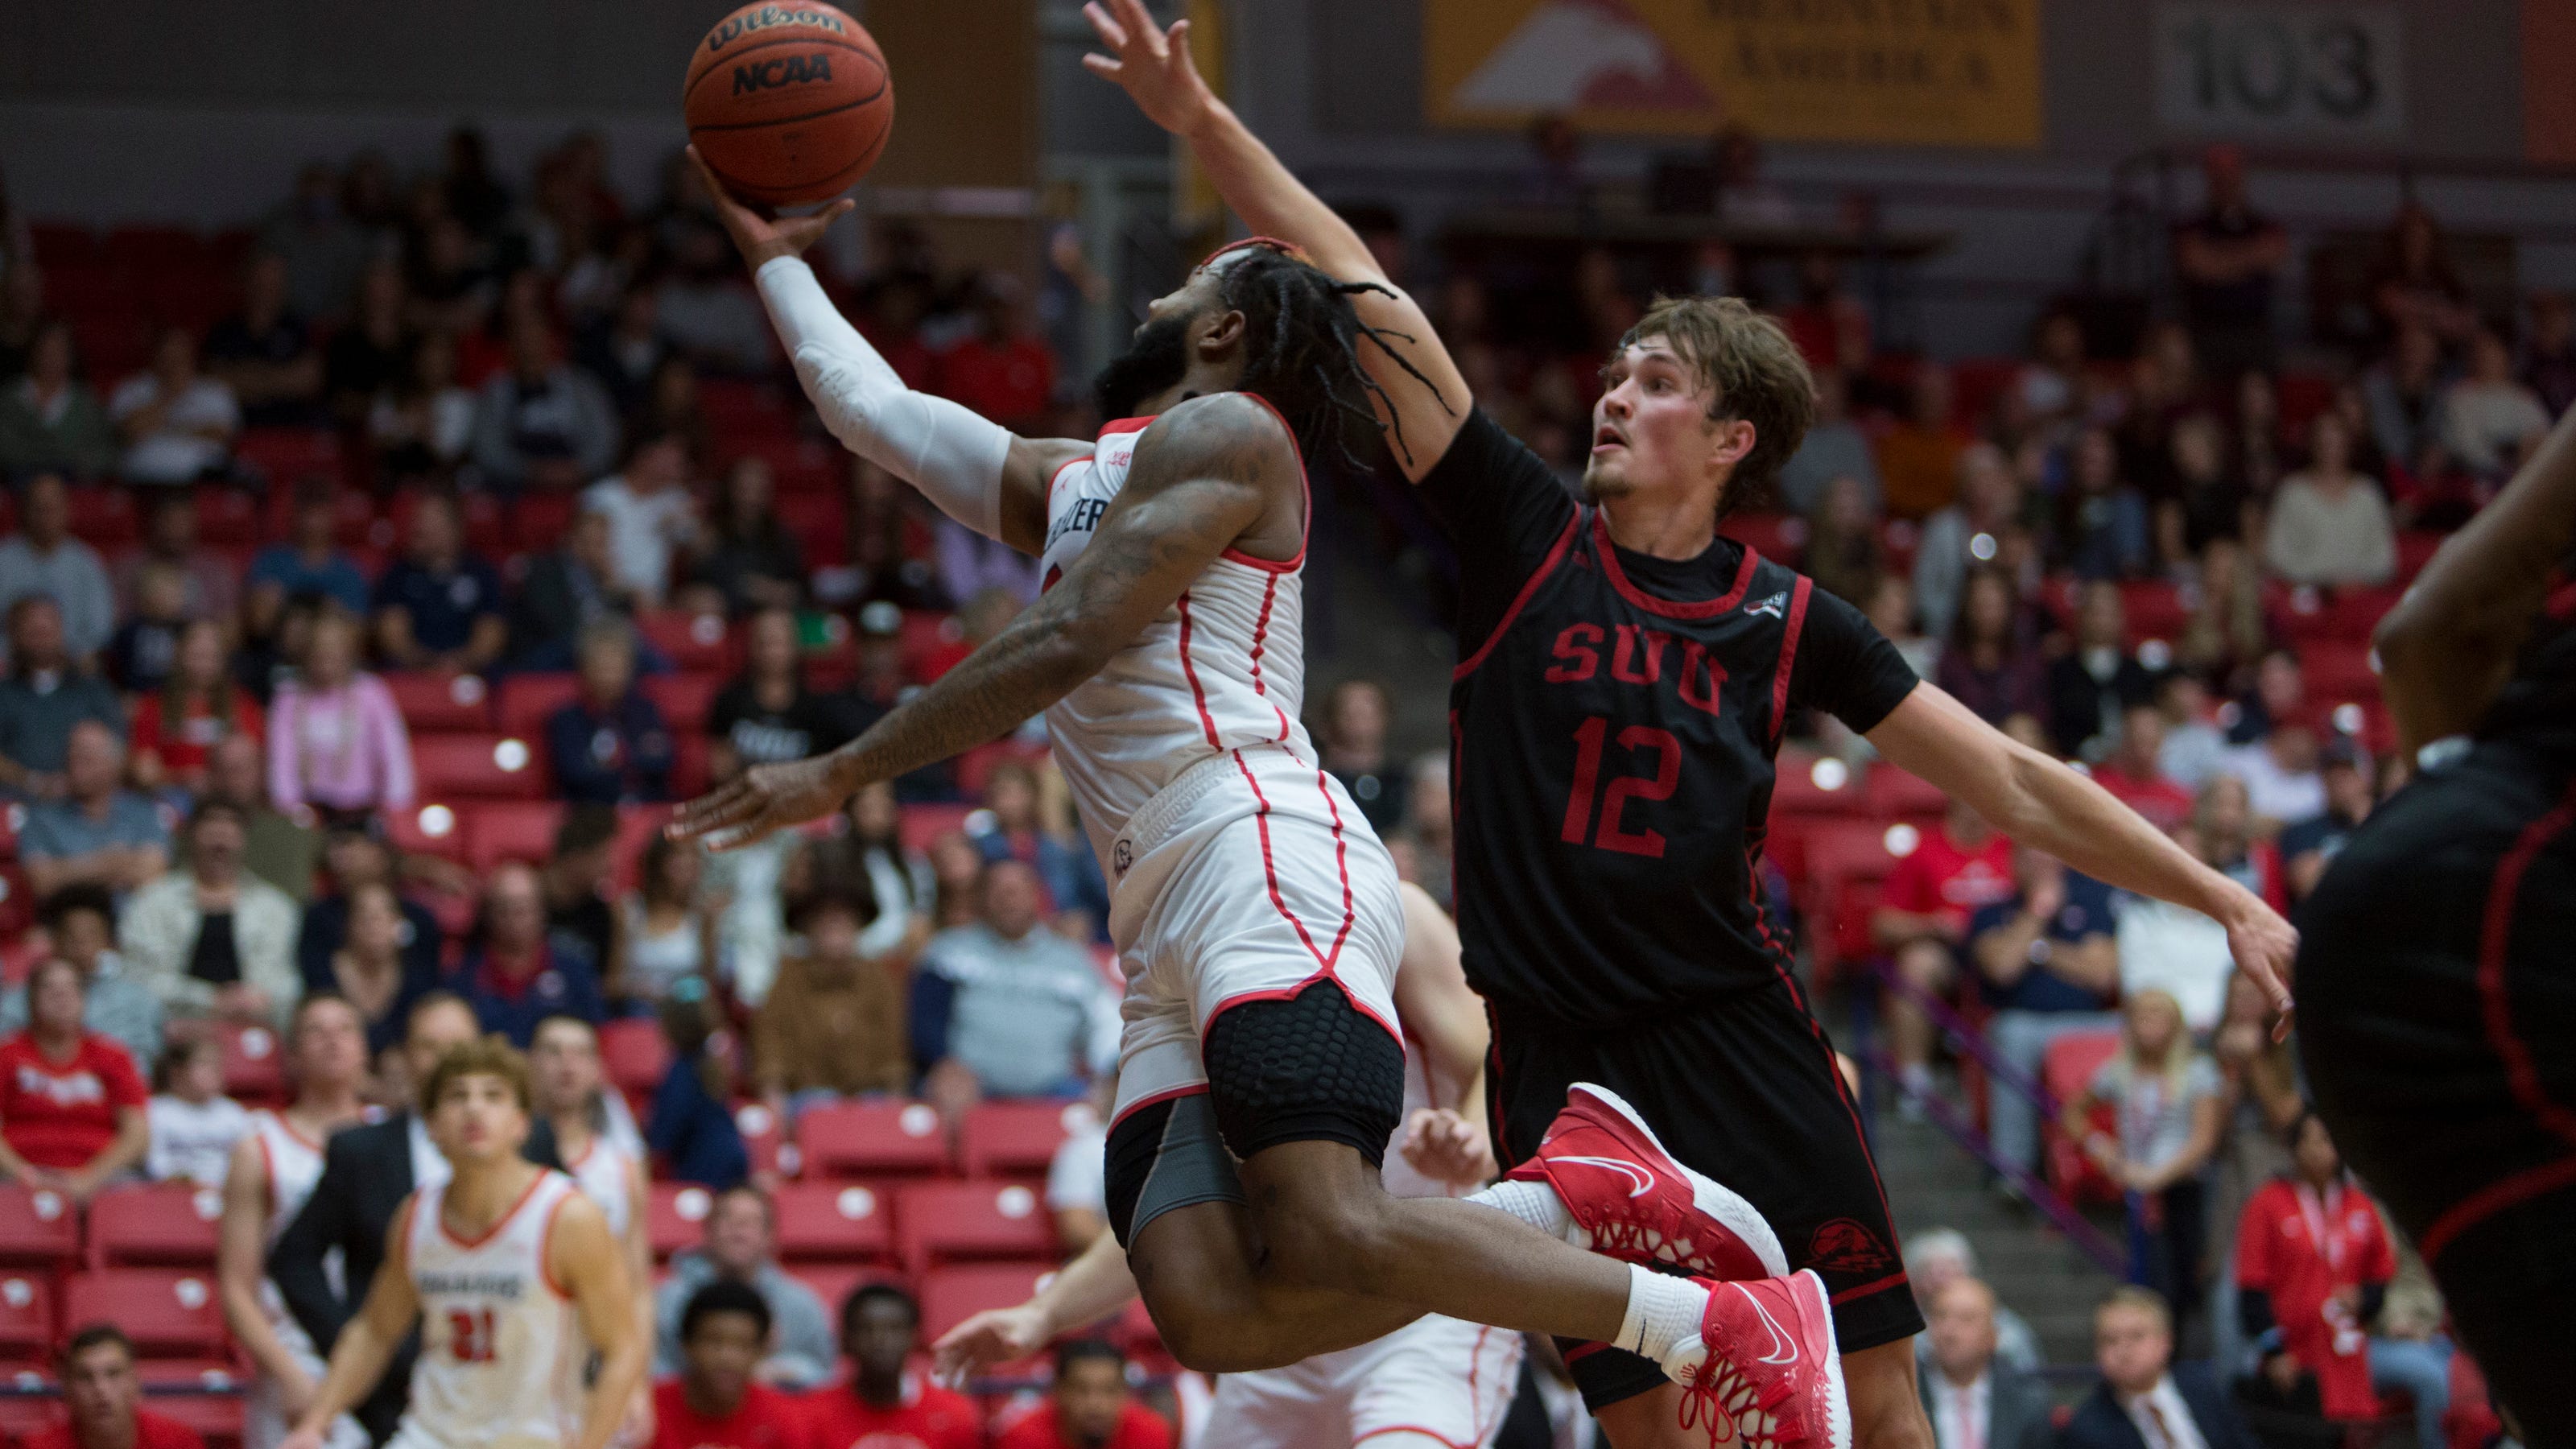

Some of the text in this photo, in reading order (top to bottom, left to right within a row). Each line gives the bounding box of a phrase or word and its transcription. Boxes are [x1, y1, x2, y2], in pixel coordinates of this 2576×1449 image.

[709, 6, 848, 52] Wilson
[733, 54, 832, 96] NCAA
[2171, 14, 2378, 119] 103
[1544, 621, 1729, 718] SUU
[1560, 715, 1682, 859] 12
